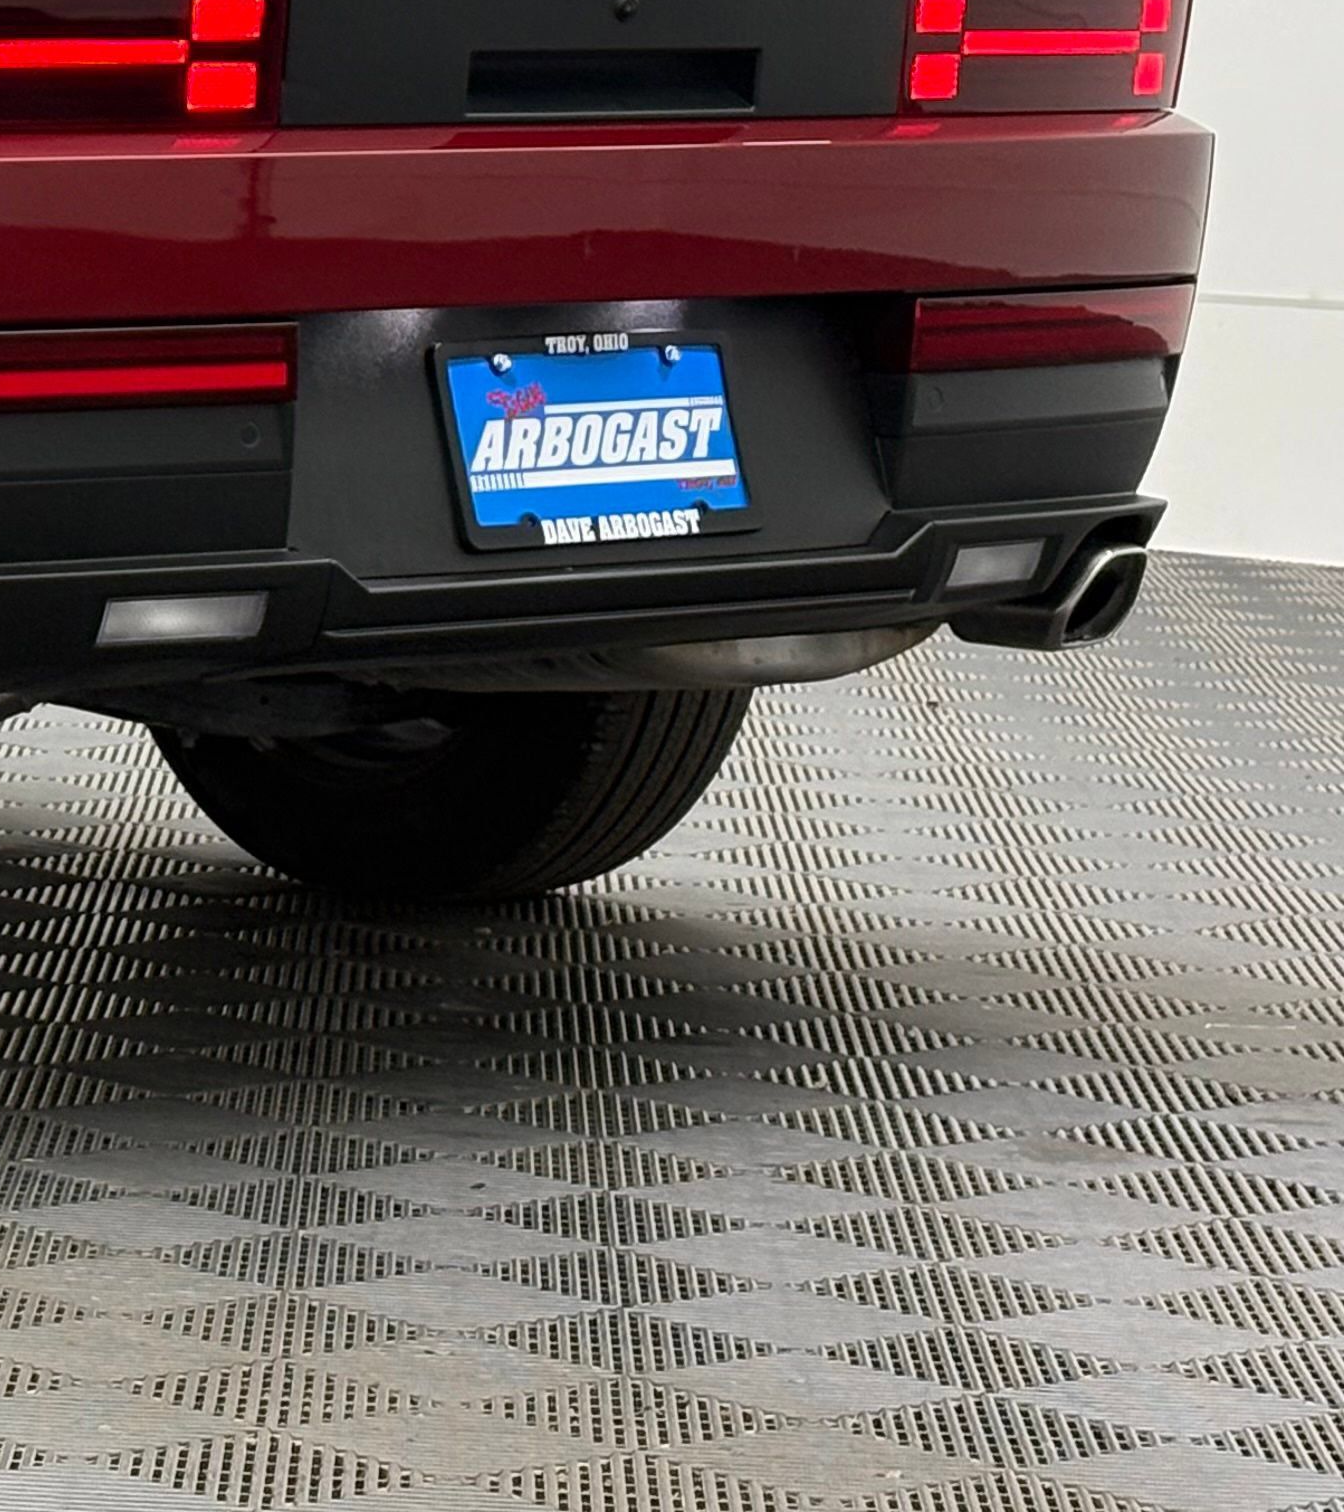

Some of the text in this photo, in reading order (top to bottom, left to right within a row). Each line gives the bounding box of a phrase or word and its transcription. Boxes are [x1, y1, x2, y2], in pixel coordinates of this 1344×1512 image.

[544, 332, 629, 355] TROY, OHIO
[469, 407, 724, 473] ARBOGAST
[540, 508, 701, 545] DAVE ARBOGAST
